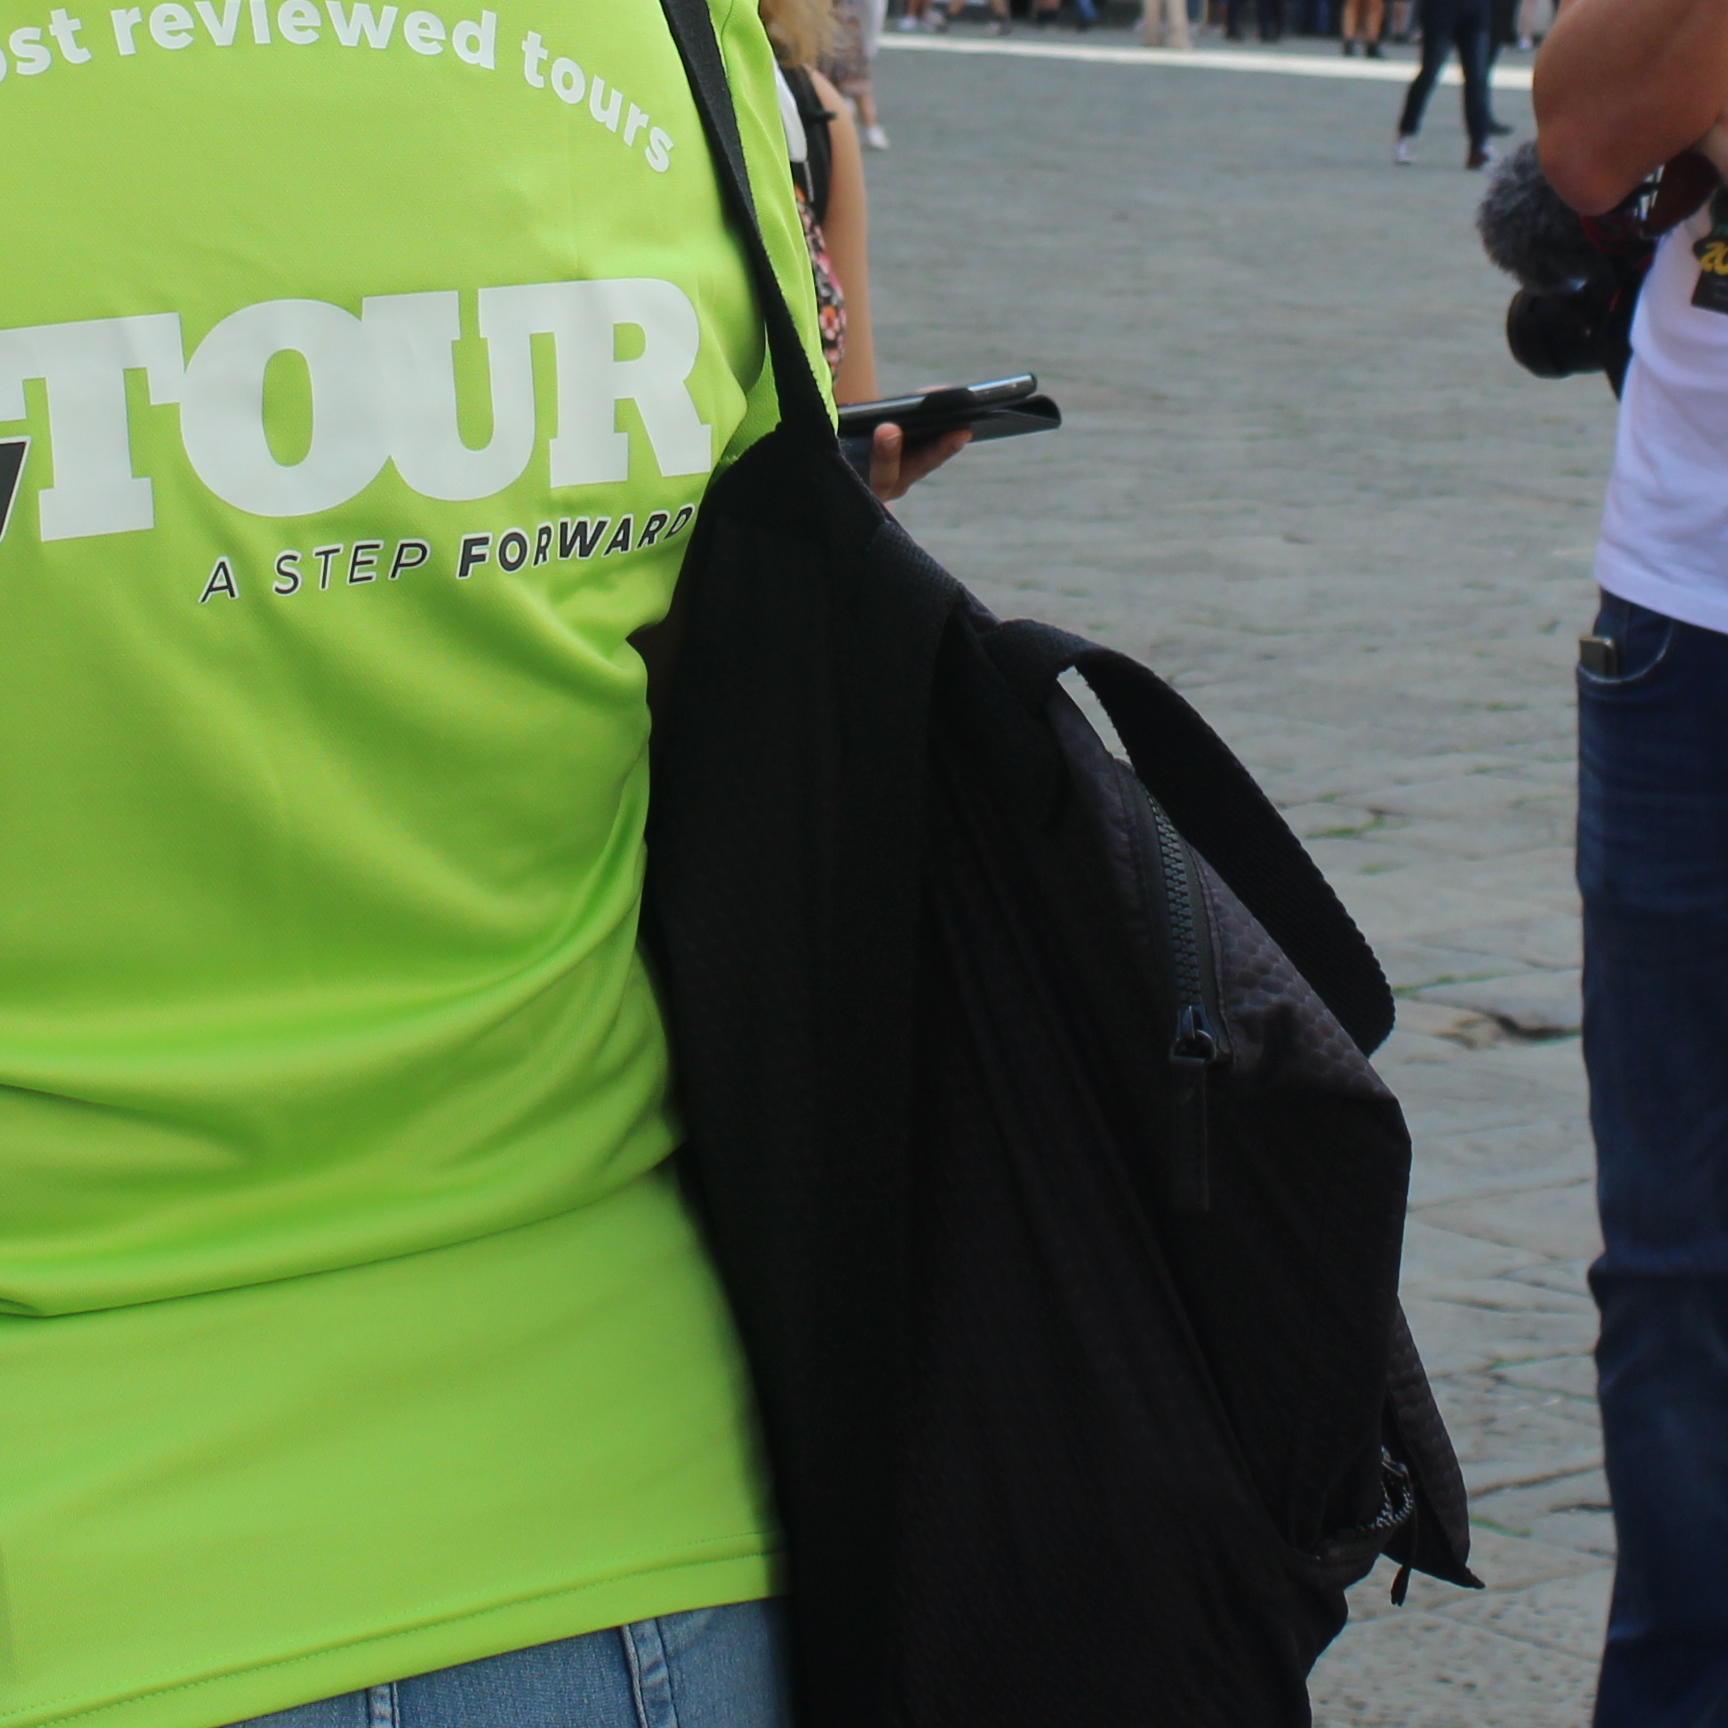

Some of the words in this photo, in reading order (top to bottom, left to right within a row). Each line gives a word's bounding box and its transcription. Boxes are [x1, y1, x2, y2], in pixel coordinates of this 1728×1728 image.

[521, 30, 675, 174] tours
[200, 558, 239, 603] A
[274, 541, 429, 596] STEP
[456, 505, 694, 578] FORWARD
